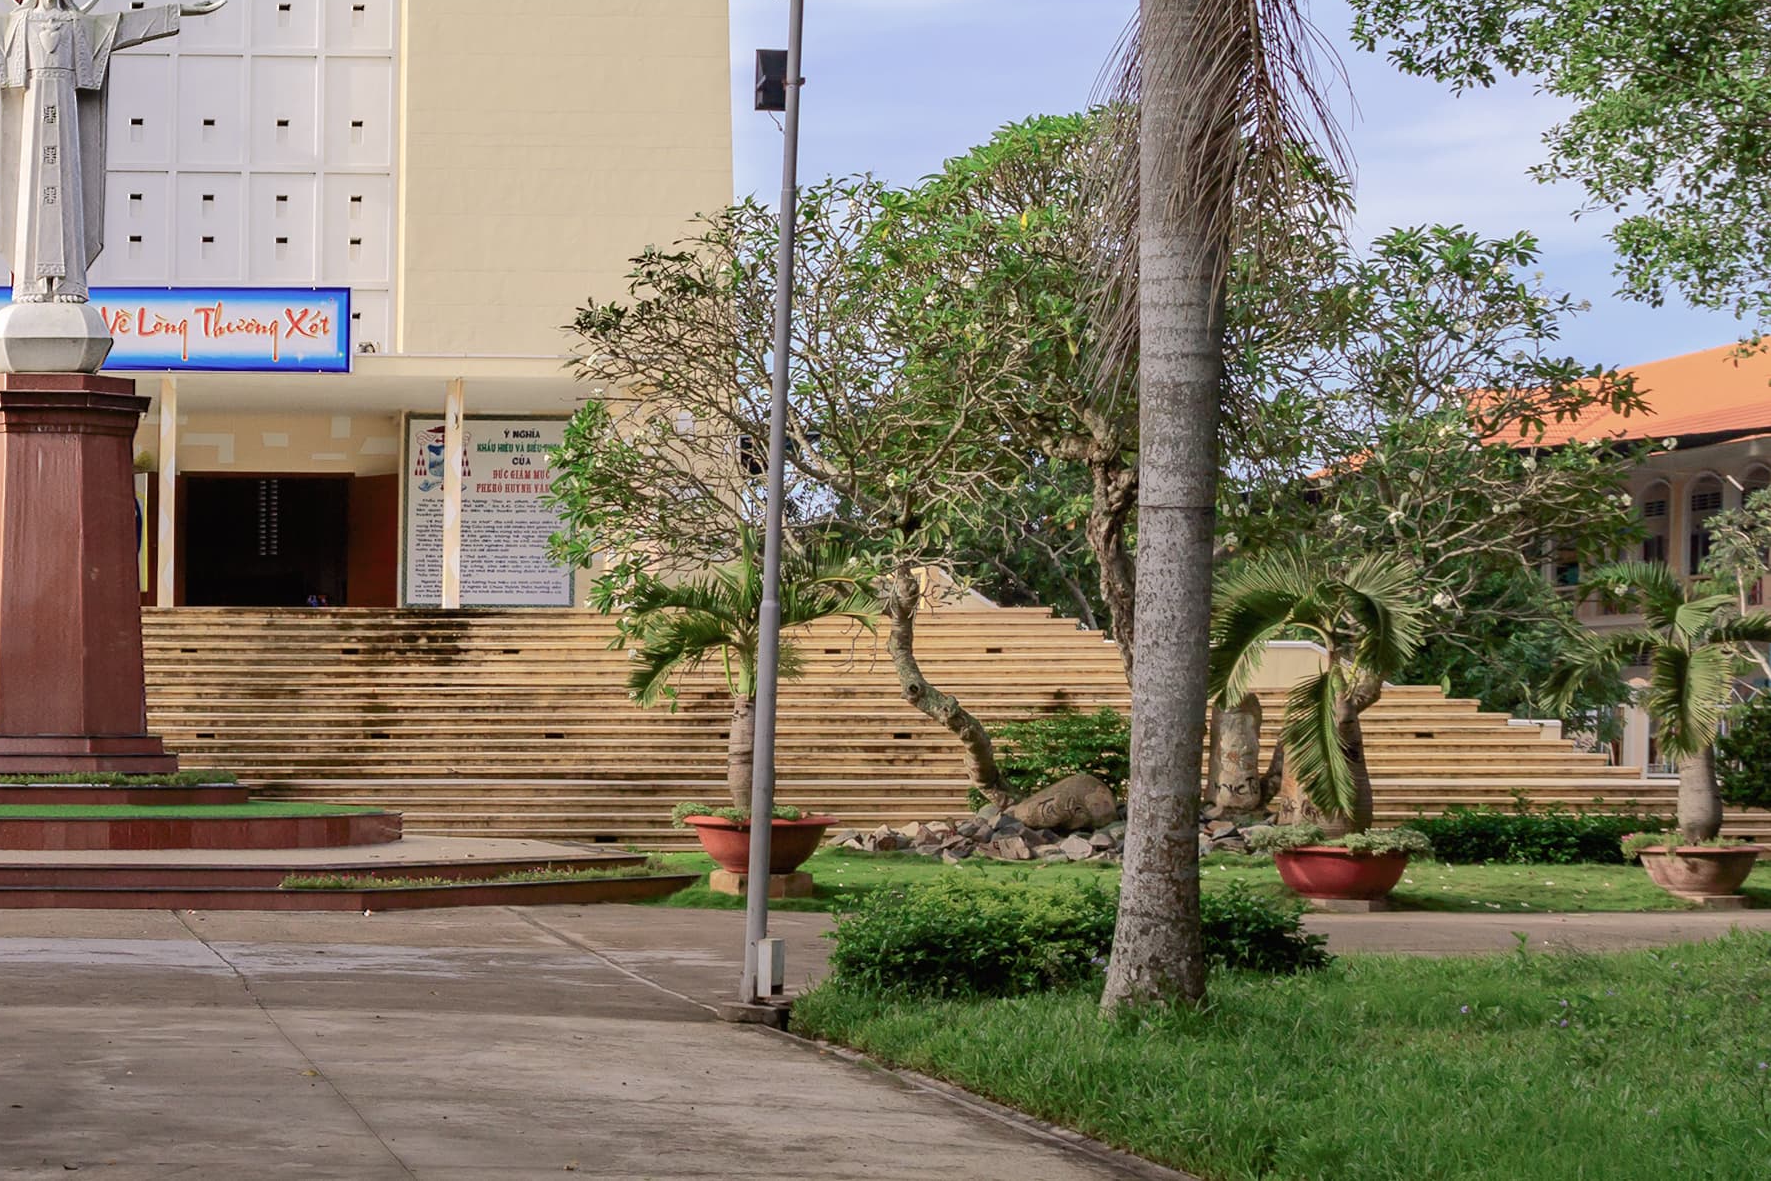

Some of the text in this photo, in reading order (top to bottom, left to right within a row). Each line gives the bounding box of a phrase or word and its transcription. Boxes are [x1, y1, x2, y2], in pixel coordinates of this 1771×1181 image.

[137, 306, 189, 361] Lòng
[194, 300, 279, 362] Thương
[285, 307, 331, 339] Xót
[511, 454, 531, 465] CỦA
